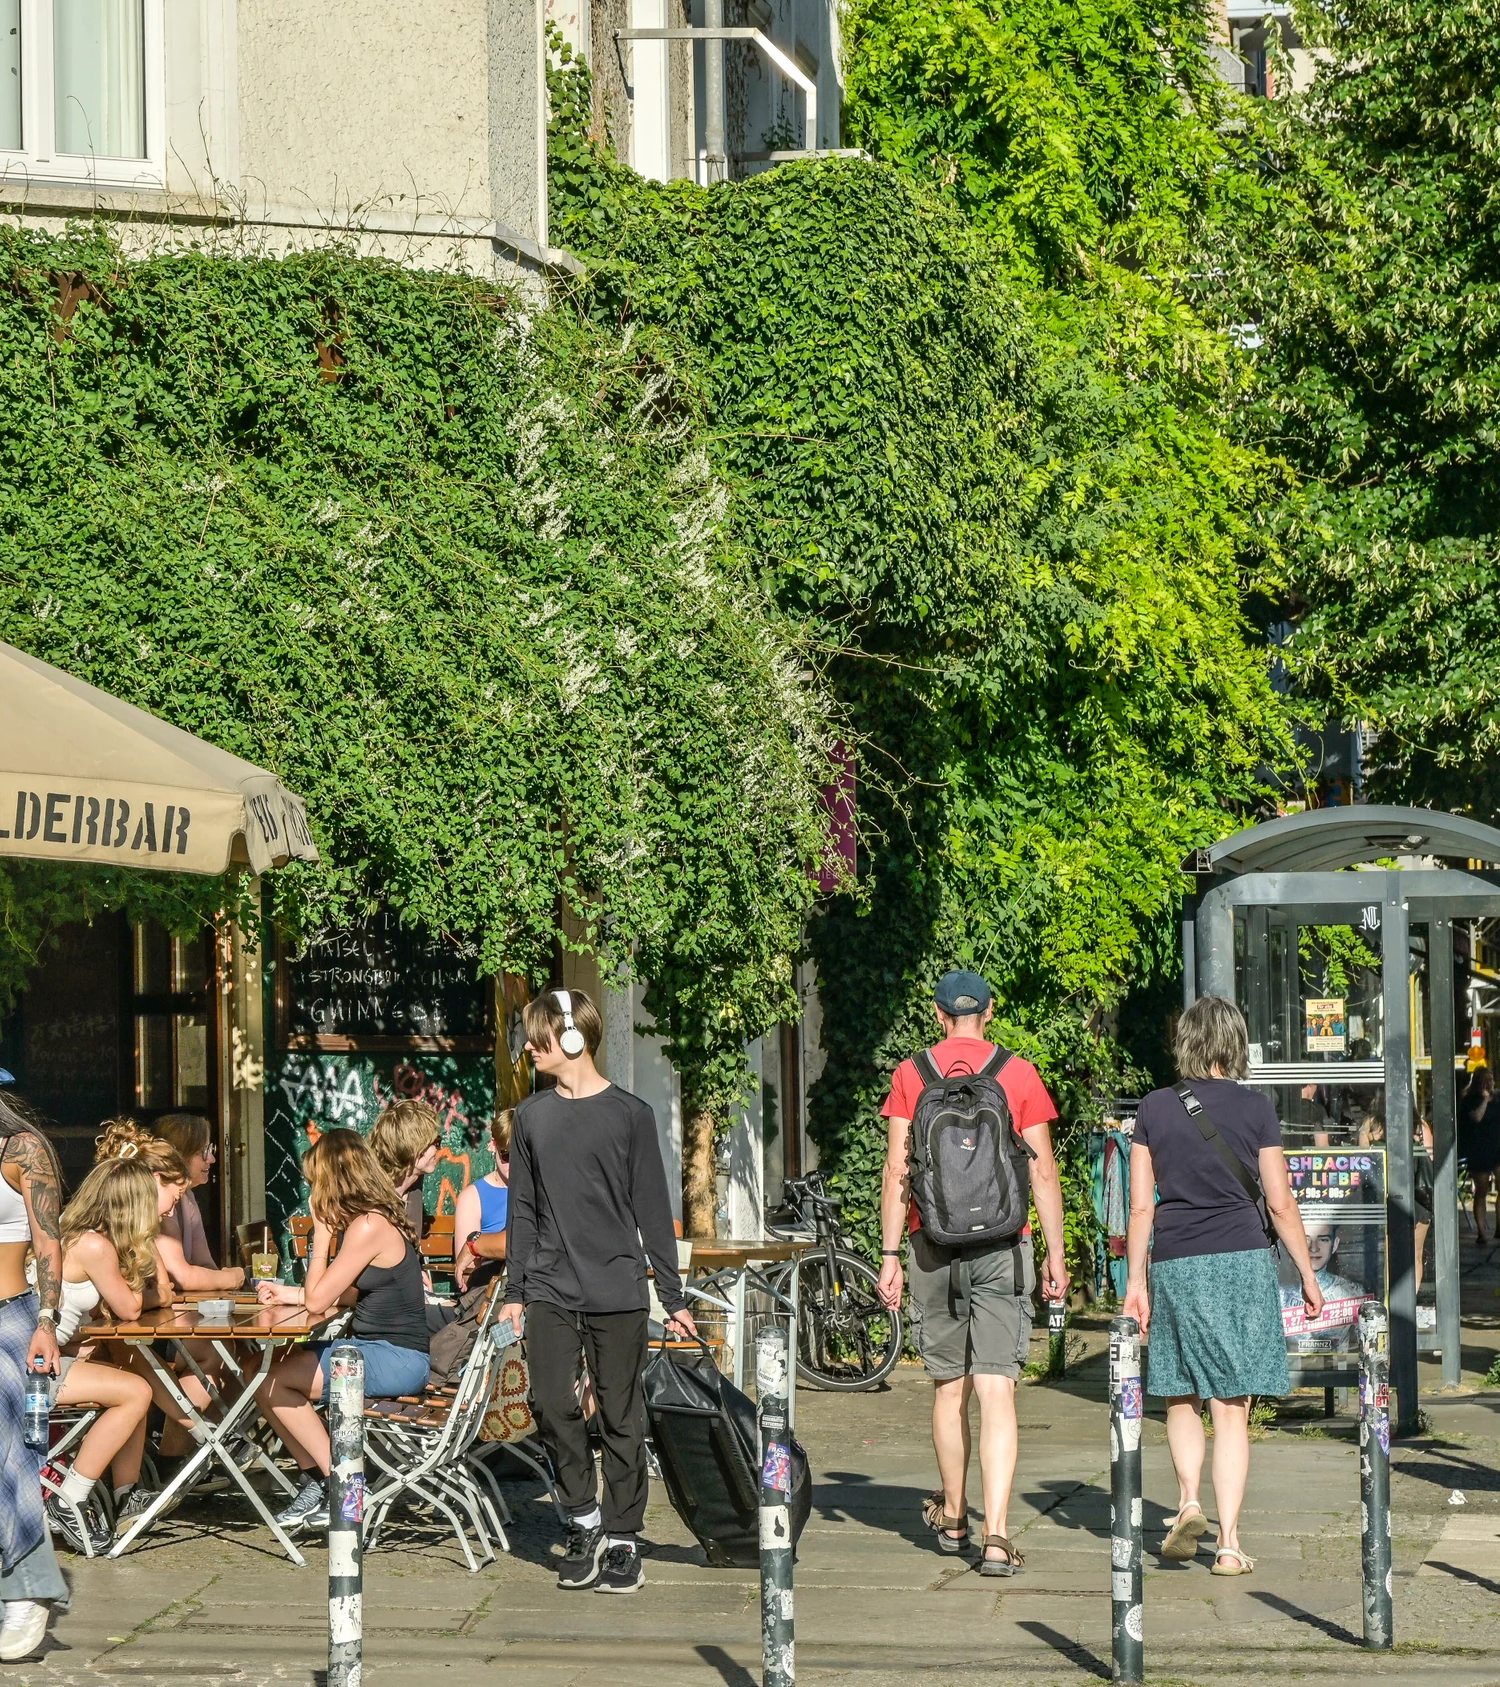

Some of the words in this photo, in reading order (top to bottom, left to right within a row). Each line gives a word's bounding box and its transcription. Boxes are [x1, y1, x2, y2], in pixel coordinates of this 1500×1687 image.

[1312, 1171, 1361, 1186] LIEBE
[1329, 1307, 1353, 1319] 22:00
[1301, 1340, 1329, 1348] FRANNZ
